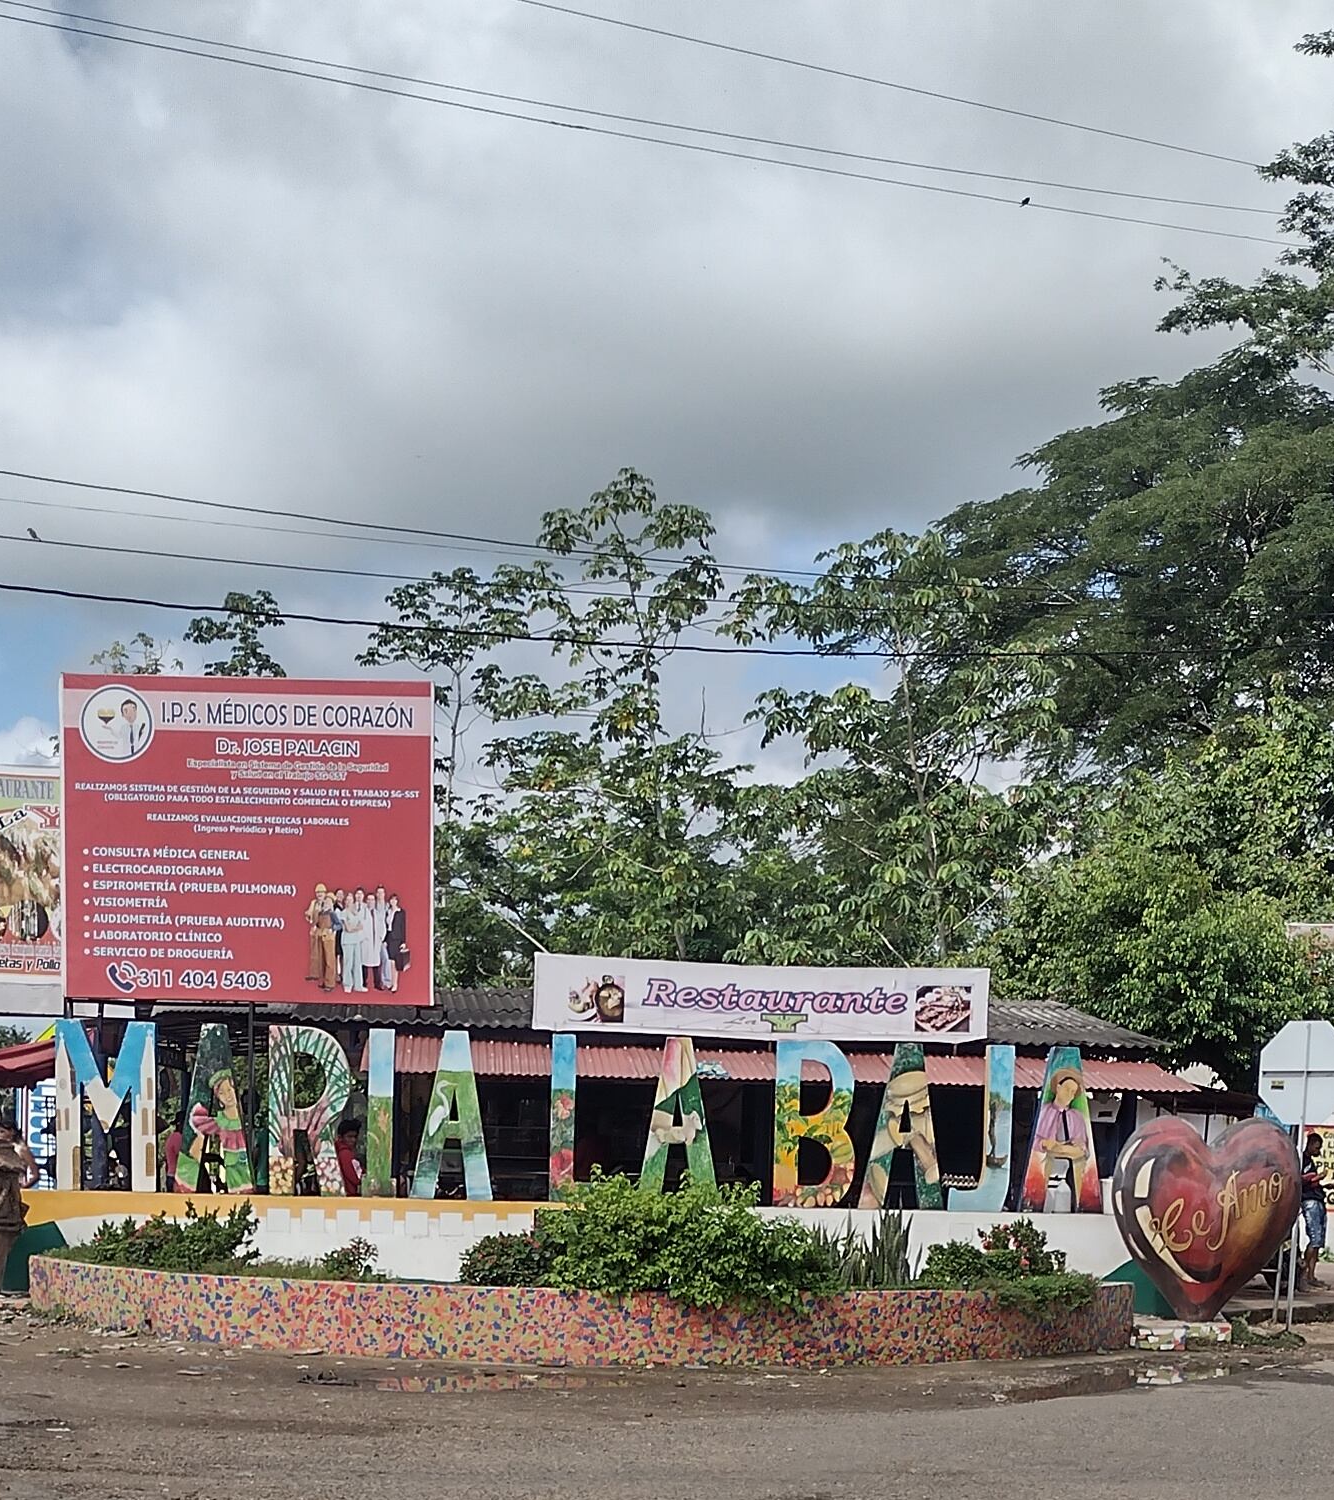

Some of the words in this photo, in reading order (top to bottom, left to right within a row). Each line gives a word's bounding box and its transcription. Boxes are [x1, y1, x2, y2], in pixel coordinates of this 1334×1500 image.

[162, 702, 201, 723] I.P.S.
[207, 698, 287, 726] MÉDICOS
[293, 705, 317, 726] DE
[323, 701, 413, 728] CORAZÓN
[217, 738, 240, 754] Dr.
[244, 739, 281, 756] JOSE
[285, 740, 360, 757] PALACIN
[187, 758, 236, 769] Especialista
[236, 761, 247, 769] en
[249, 760, 281, 769] Sistema
[282, 761, 293, 769] de
[294, 761, 325, 771] Gestión
[327, 762, 337, 771] de
[338, 762, 347, 771] la
[347, 763, 389, 773] Seguridad
[231, 770, 237, 780] y
[238, 770, 263, 778] Salud
[263, 771, 274, 779] en
[275, 771, 283, 779] el
[284, 771, 314, 781] Trabajo
[75, 782, 127, 791] REALIZAMOS
[129, 783, 165, 792] SISTEMA
[167, 785, 178, 793] DE
[179, 784, 216, 794] GESTIÓN
[218, 786, 229, 794] DE
[231, 786, 241, 795] LA
[243, 787, 291, 796] SEGURIDAD
[293, 788, 299, 796] Y
[300, 788, 327, 796] SALUD
[329, 788, 340, 797] EN
[342, 789, 351, 797] EL
[353, 789, 389, 798] TRABAJO
[391, 790, 419, 798] SG-SST
[104, 793, 165, 802] (OBLIGATORIO
[167, 795, 189, 803] PARA
[191, 795, 213, 803] TODO
[215, 796, 291, 805] ESTABLECIMIENTO
[292, 797, 340, 806] COMERCIAL
[350, 799, 391, 809] EMPRESA)
[147, 813, 199, 822] REALIZAMOS
[201, 815, 262, 824] EVALUACIONES
[303, 817, 349, 826] LABORALES
[193, 824, 228, 834] (Ingreso
[230, 825, 266, 834] Periódico
[267, 827, 273, 836] y
[275, 826, 303, 836] Retiro)
[92, 846, 151, 858] CONSULTA
[153, 845, 197, 860] MÉDICA
[199, 849, 250, 861] GENERAL
[92, 863, 224, 877] ELECTROCARDIOGRAMA
[92, 879, 177, 892] ESPIROMETRÍA
[179, 882, 228, 894] (PRUEBA
[230, 883, 297, 897] PULMONAR)
[92, 896, 168, 908] VISIOMETRÍA
[93, 912, 172, 925] AUDIOMETRÍA
[174, 915, 223, 927] (PRUEBA
[225, 917, 285, 930] AUDITIVA)
[93, 929, 172, 942] LABORATORIO
[175, 929, 222, 942] CLÍNICO
[93, 946, 148, 957] SERVICIO
[150, 948, 165, 958] DE
[167, 946, 234, 960] DROGUERÍA
[27, 960, 33, 972] y
[138, 969, 172, 988] 311
[179, 970, 216, 988] 404
[222, 972, 270, 989] 5403
[642, 978, 908, 1014] Restaurante
[55, 1019, 494, 1202] MARIA
[774, 1040, 1103, 1212] BAJA
[1206, 1170, 1283, 1251] Amo
